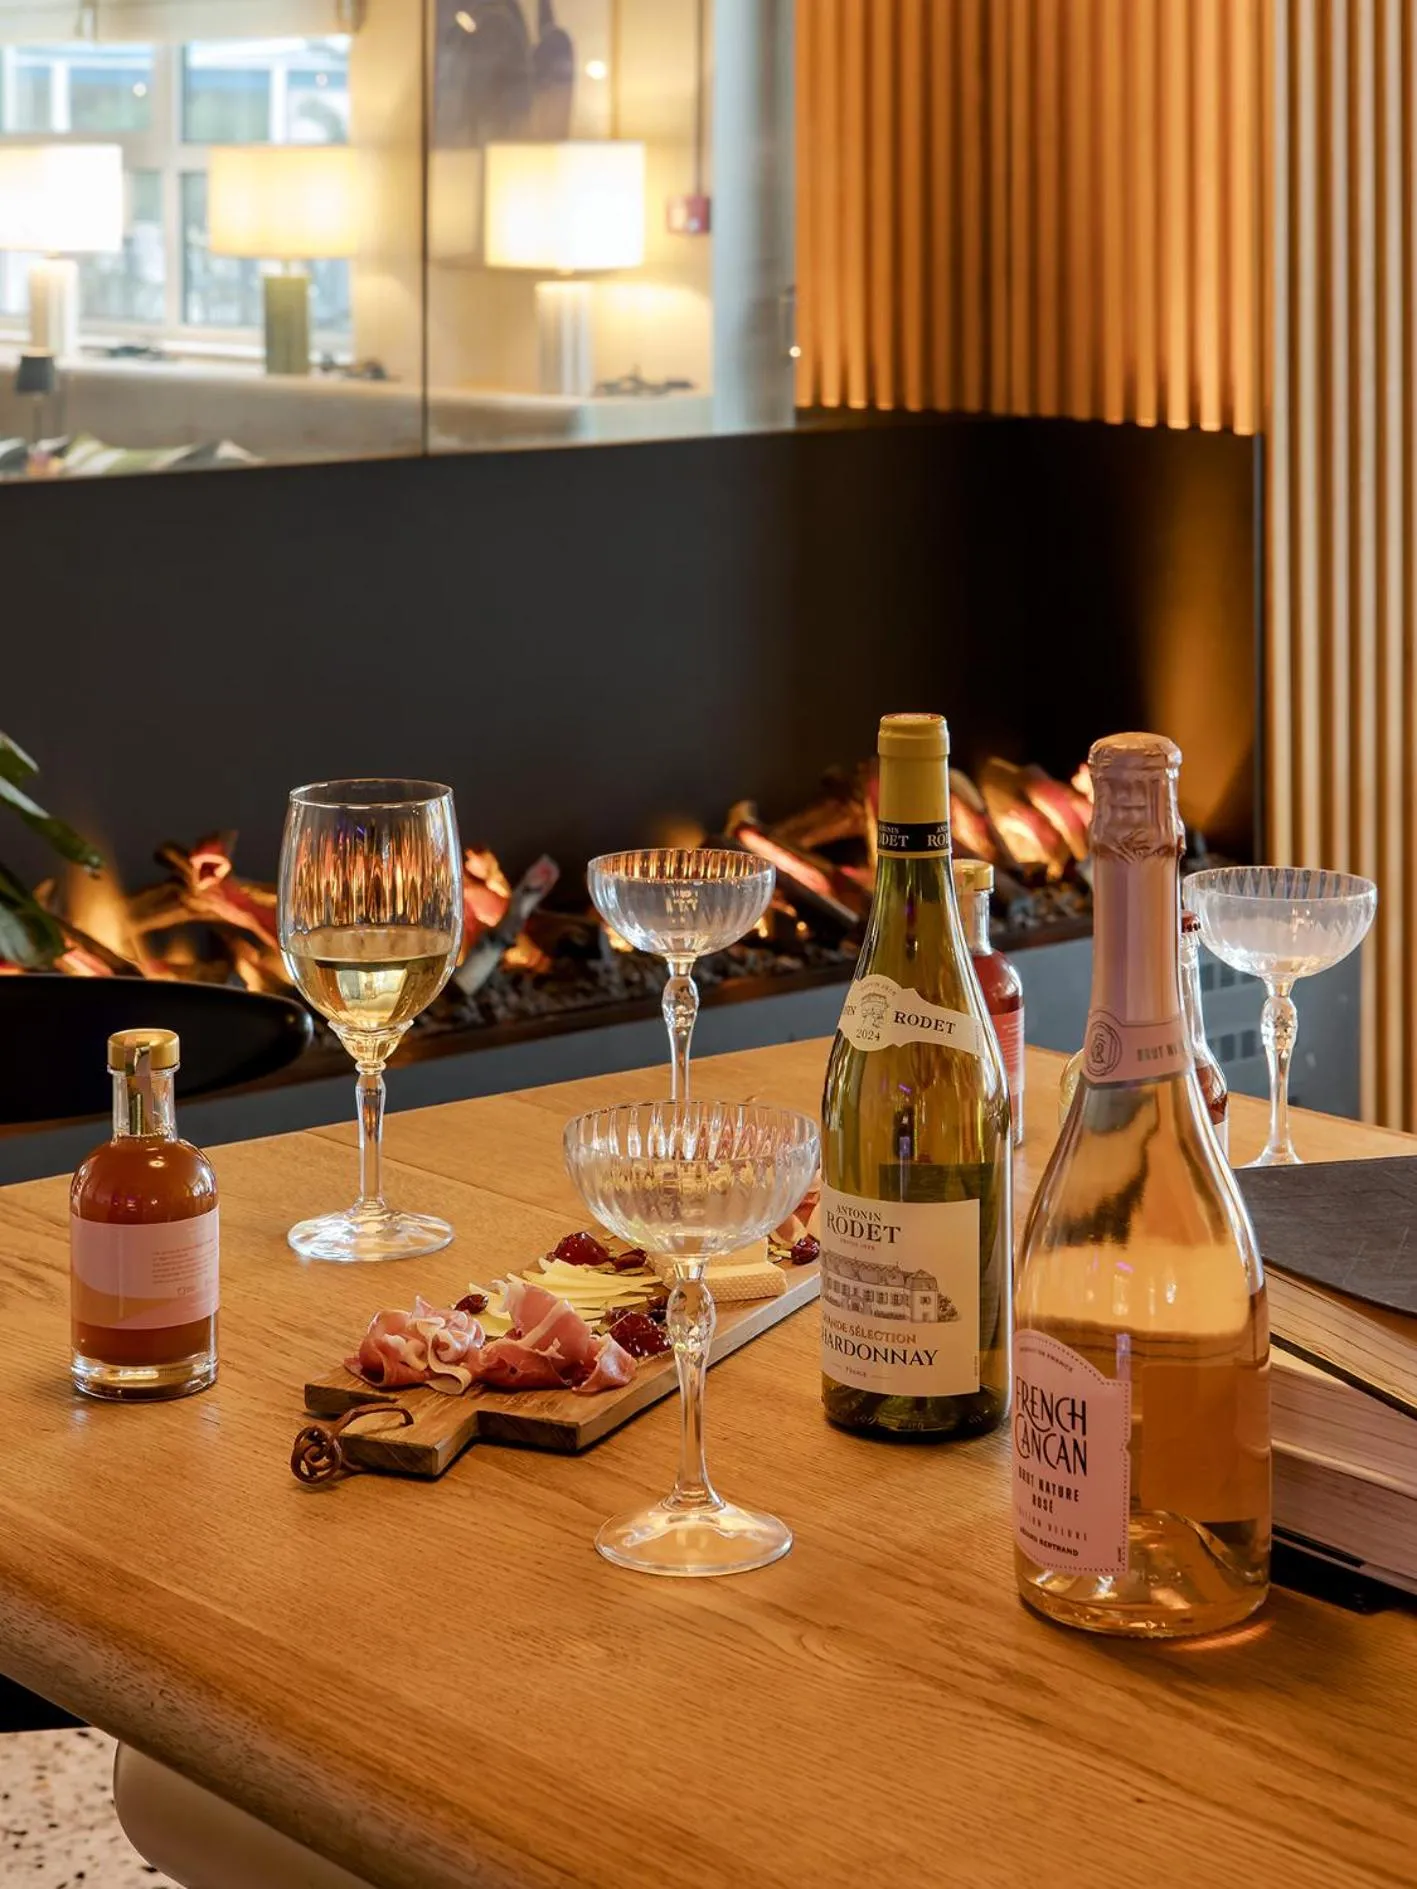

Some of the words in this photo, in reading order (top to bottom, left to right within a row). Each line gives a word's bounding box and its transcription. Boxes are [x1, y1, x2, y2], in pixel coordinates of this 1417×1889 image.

[880, 834, 909, 847] DET
[855, 1028, 881, 1041] 2024
[893, 1010, 957, 1035] RODET
[836, 1204, 882, 1222] ANTONIN
[826, 1209, 902, 1244] RODET
[822, 1326, 940, 1366] HARDONNAY
[849, 1323, 918, 1345] SÉLECTION
[1015, 1375, 1087, 1437] FRENCH
[1014, 1412, 1088, 1477] CANCAN
[1038, 1478, 1080, 1503] NATURE
